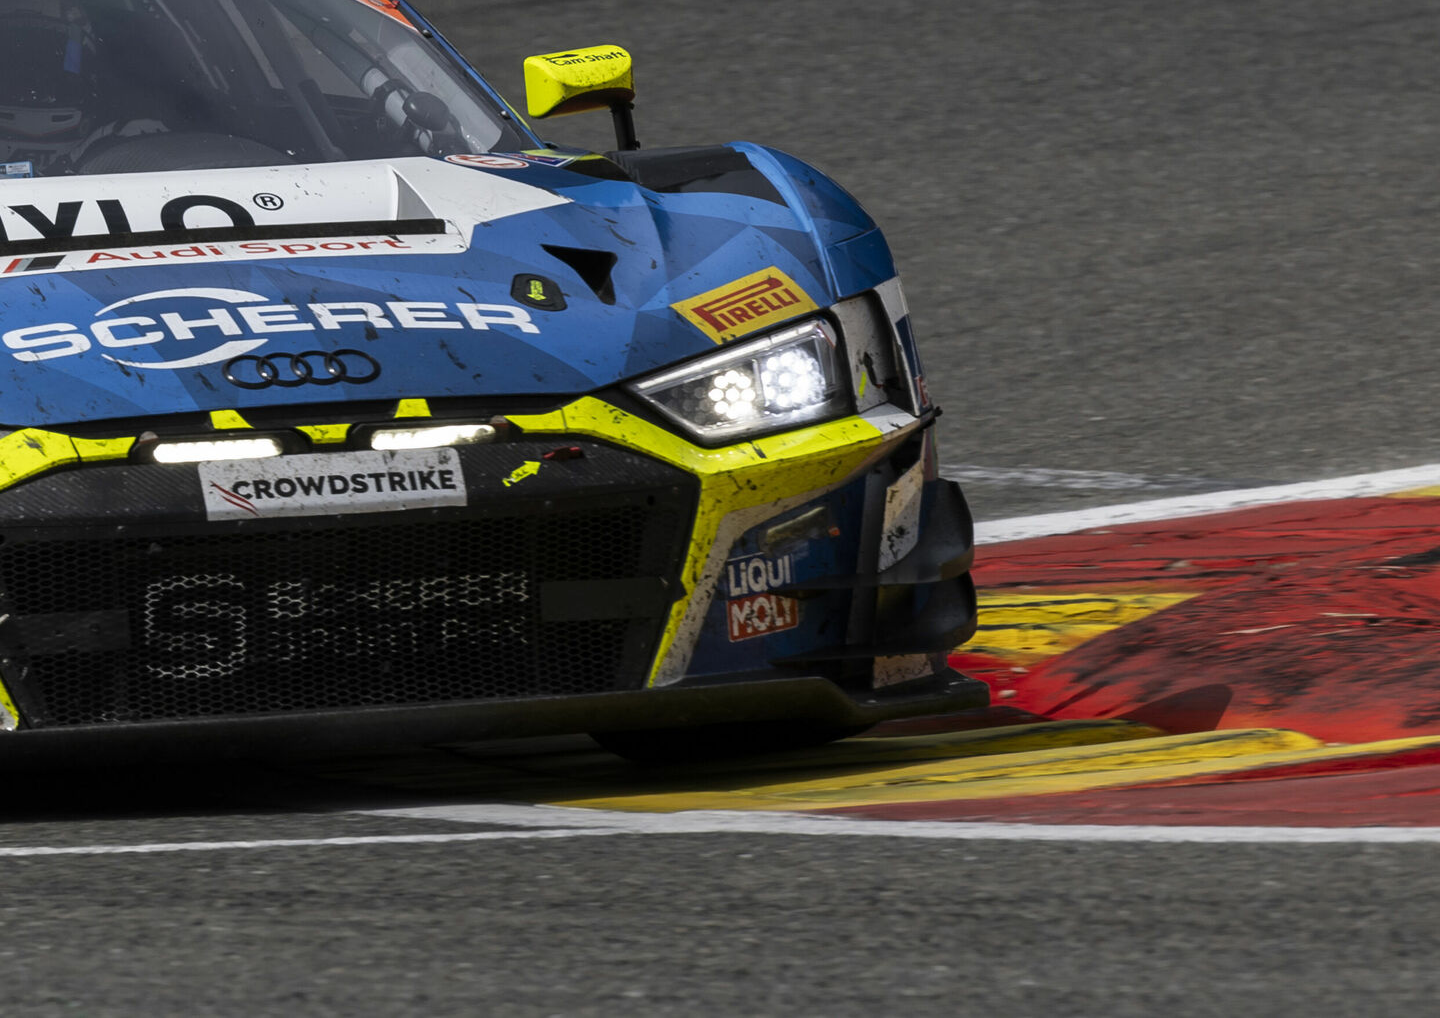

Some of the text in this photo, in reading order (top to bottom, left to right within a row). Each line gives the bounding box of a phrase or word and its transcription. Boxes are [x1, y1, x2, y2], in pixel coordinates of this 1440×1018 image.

[584, 51, 627, 63] Shaft
[86, 238, 412, 264] Audi Sport
[691, 277, 802, 332] PIRELLI
[2, 301, 542, 363] SCHERER
[231, 468, 457, 502] CROWDSTRIKE
[727, 554, 792, 598] LIQUI
[729, 595, 794, 637] MOLY
